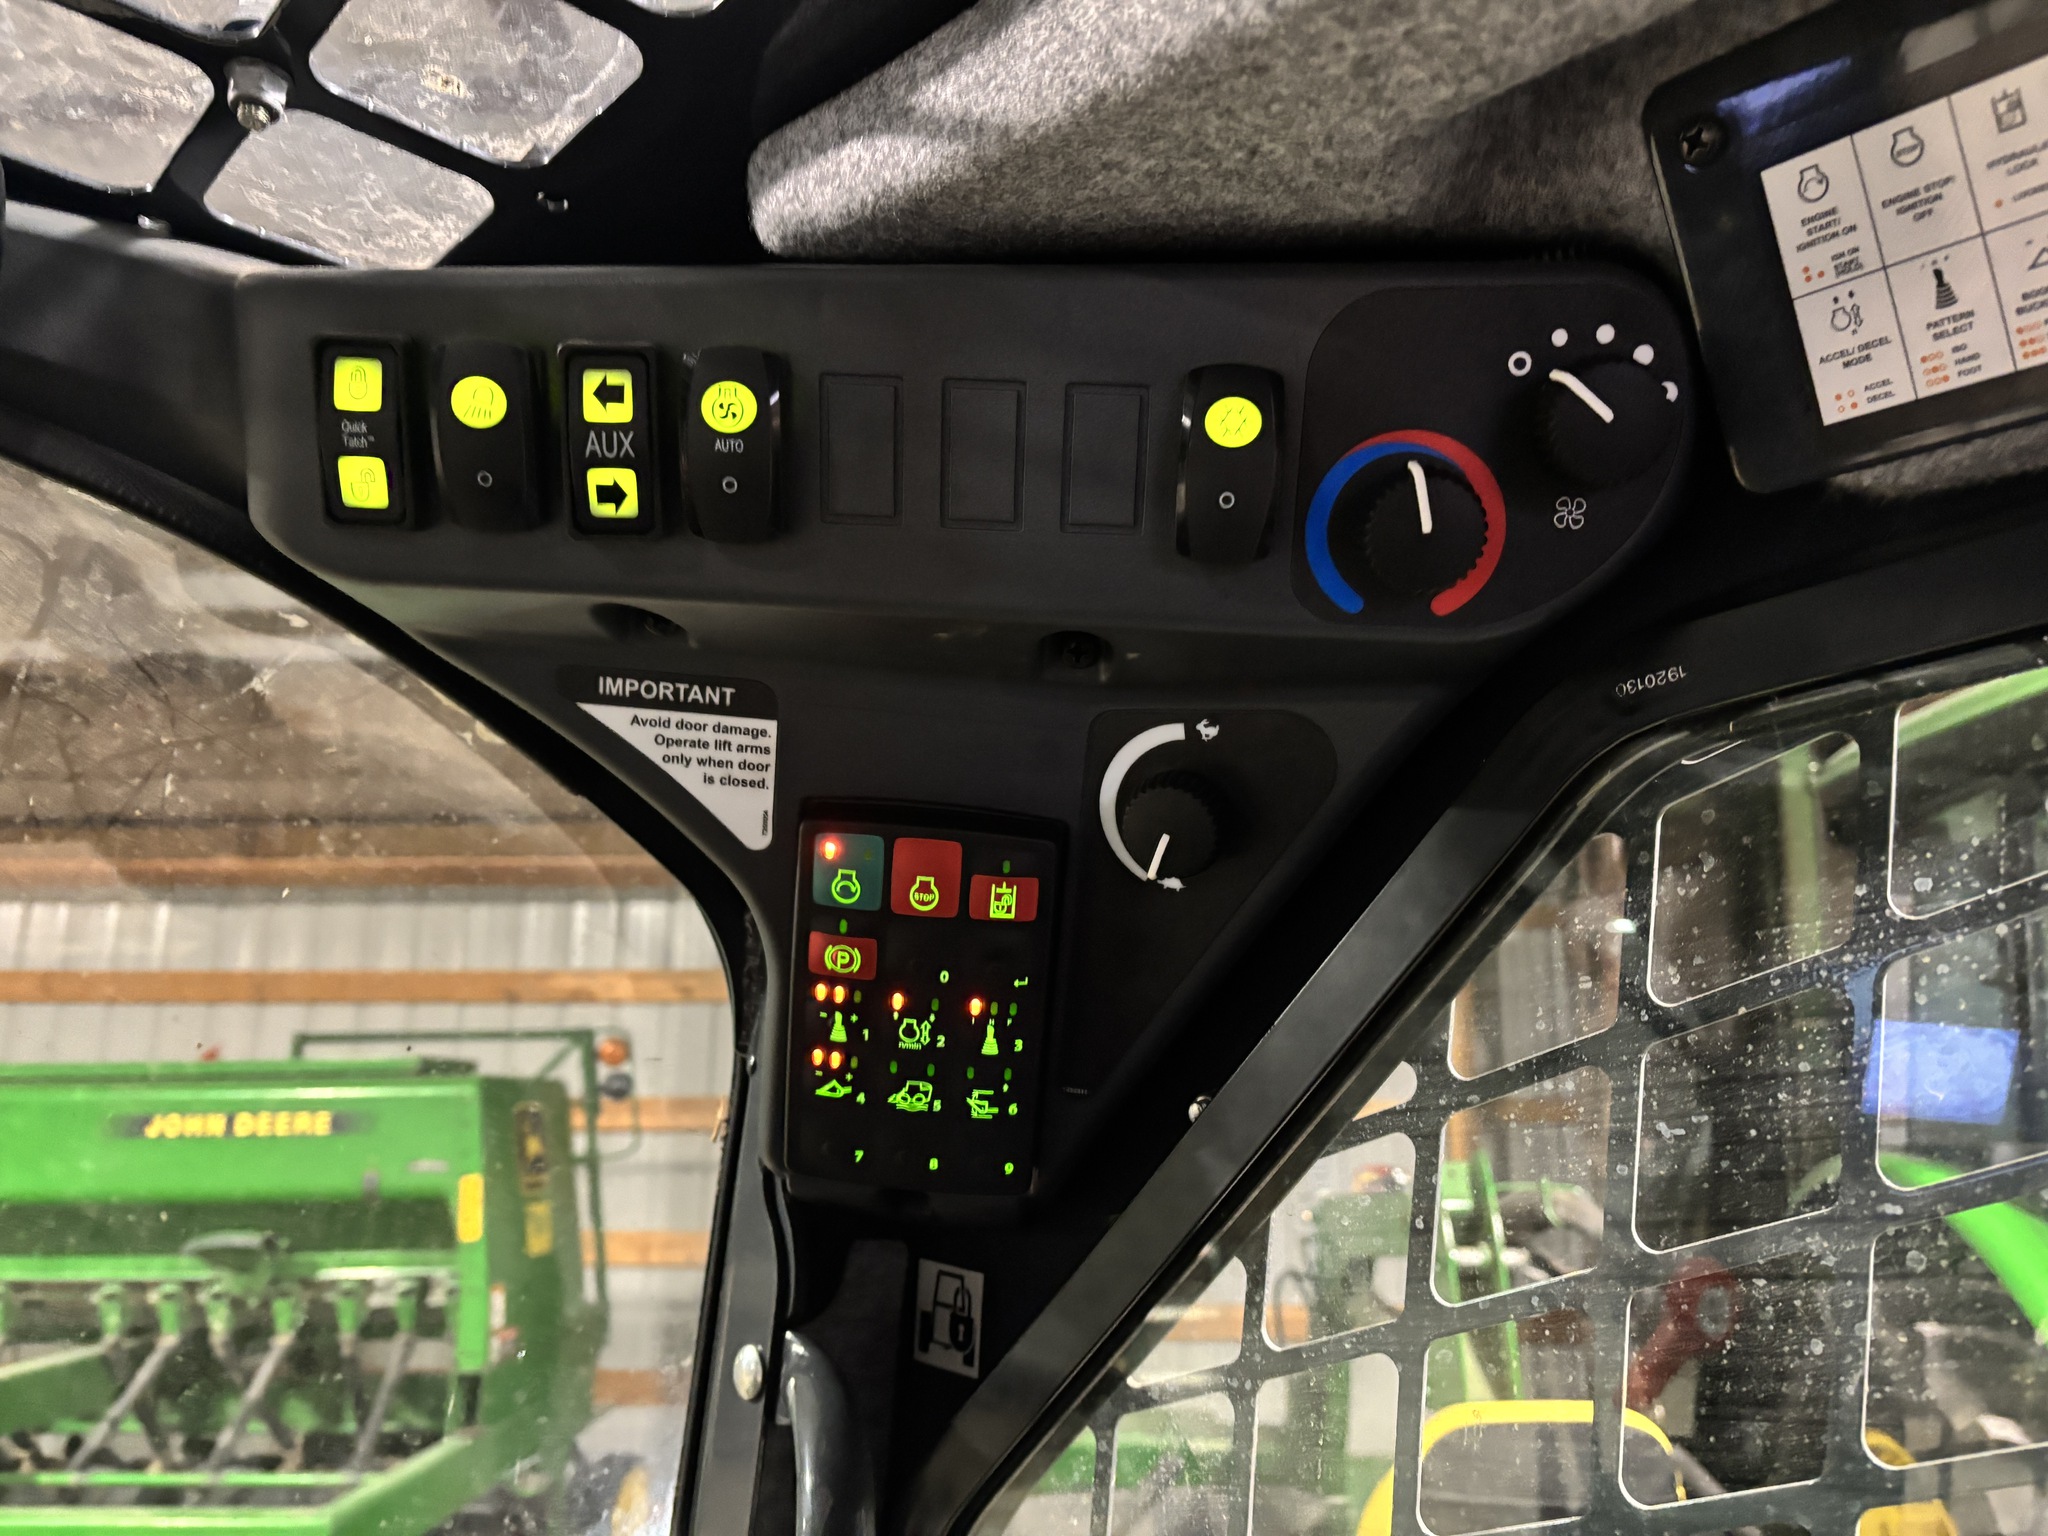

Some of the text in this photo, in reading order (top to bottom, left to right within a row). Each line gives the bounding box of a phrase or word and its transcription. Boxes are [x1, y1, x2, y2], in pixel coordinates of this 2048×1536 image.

[1801, 206, 1839, 227] ENGINE
[1926, 309, 1976, 331] PATTERN
[1932, 321, 1974, 341] SELECT
[1857, 335, 1892, 352] DECEL
[1842, 353, 1873, 370] MODE
[1864, 378, 1893, 393] ACCEL
[1866, 390, 1896, 405] DECEL
[585, 430, 636, 459] AUX
[714, 438, 745, 453] AUTO
[598, 675, 736, 707] IMPORTANT
[630, 714, 772, 739] Avoid door damage.
[654, 734, 771, 756] Operate lift arms
[662, 753, 771, 773] only when door
[703, 772, 769, 790] is closed.
[914, 891, 935, 902] STOP
[939, 970, 950, 984] 0
[862, 1028, 869, 1042] 1
[936, 1034, 946, 1048] 2
[1013, 1038, 1023, 1052] 3
[856, 1092, 866, 1105] 4
[1008, 1103, 1018, 1116] 6
[143, 1110, 333, 1139] JOHN DEERE
[855, 1149, 864, 1163] 7
[1004, 1162, 1014, 1175] 9
